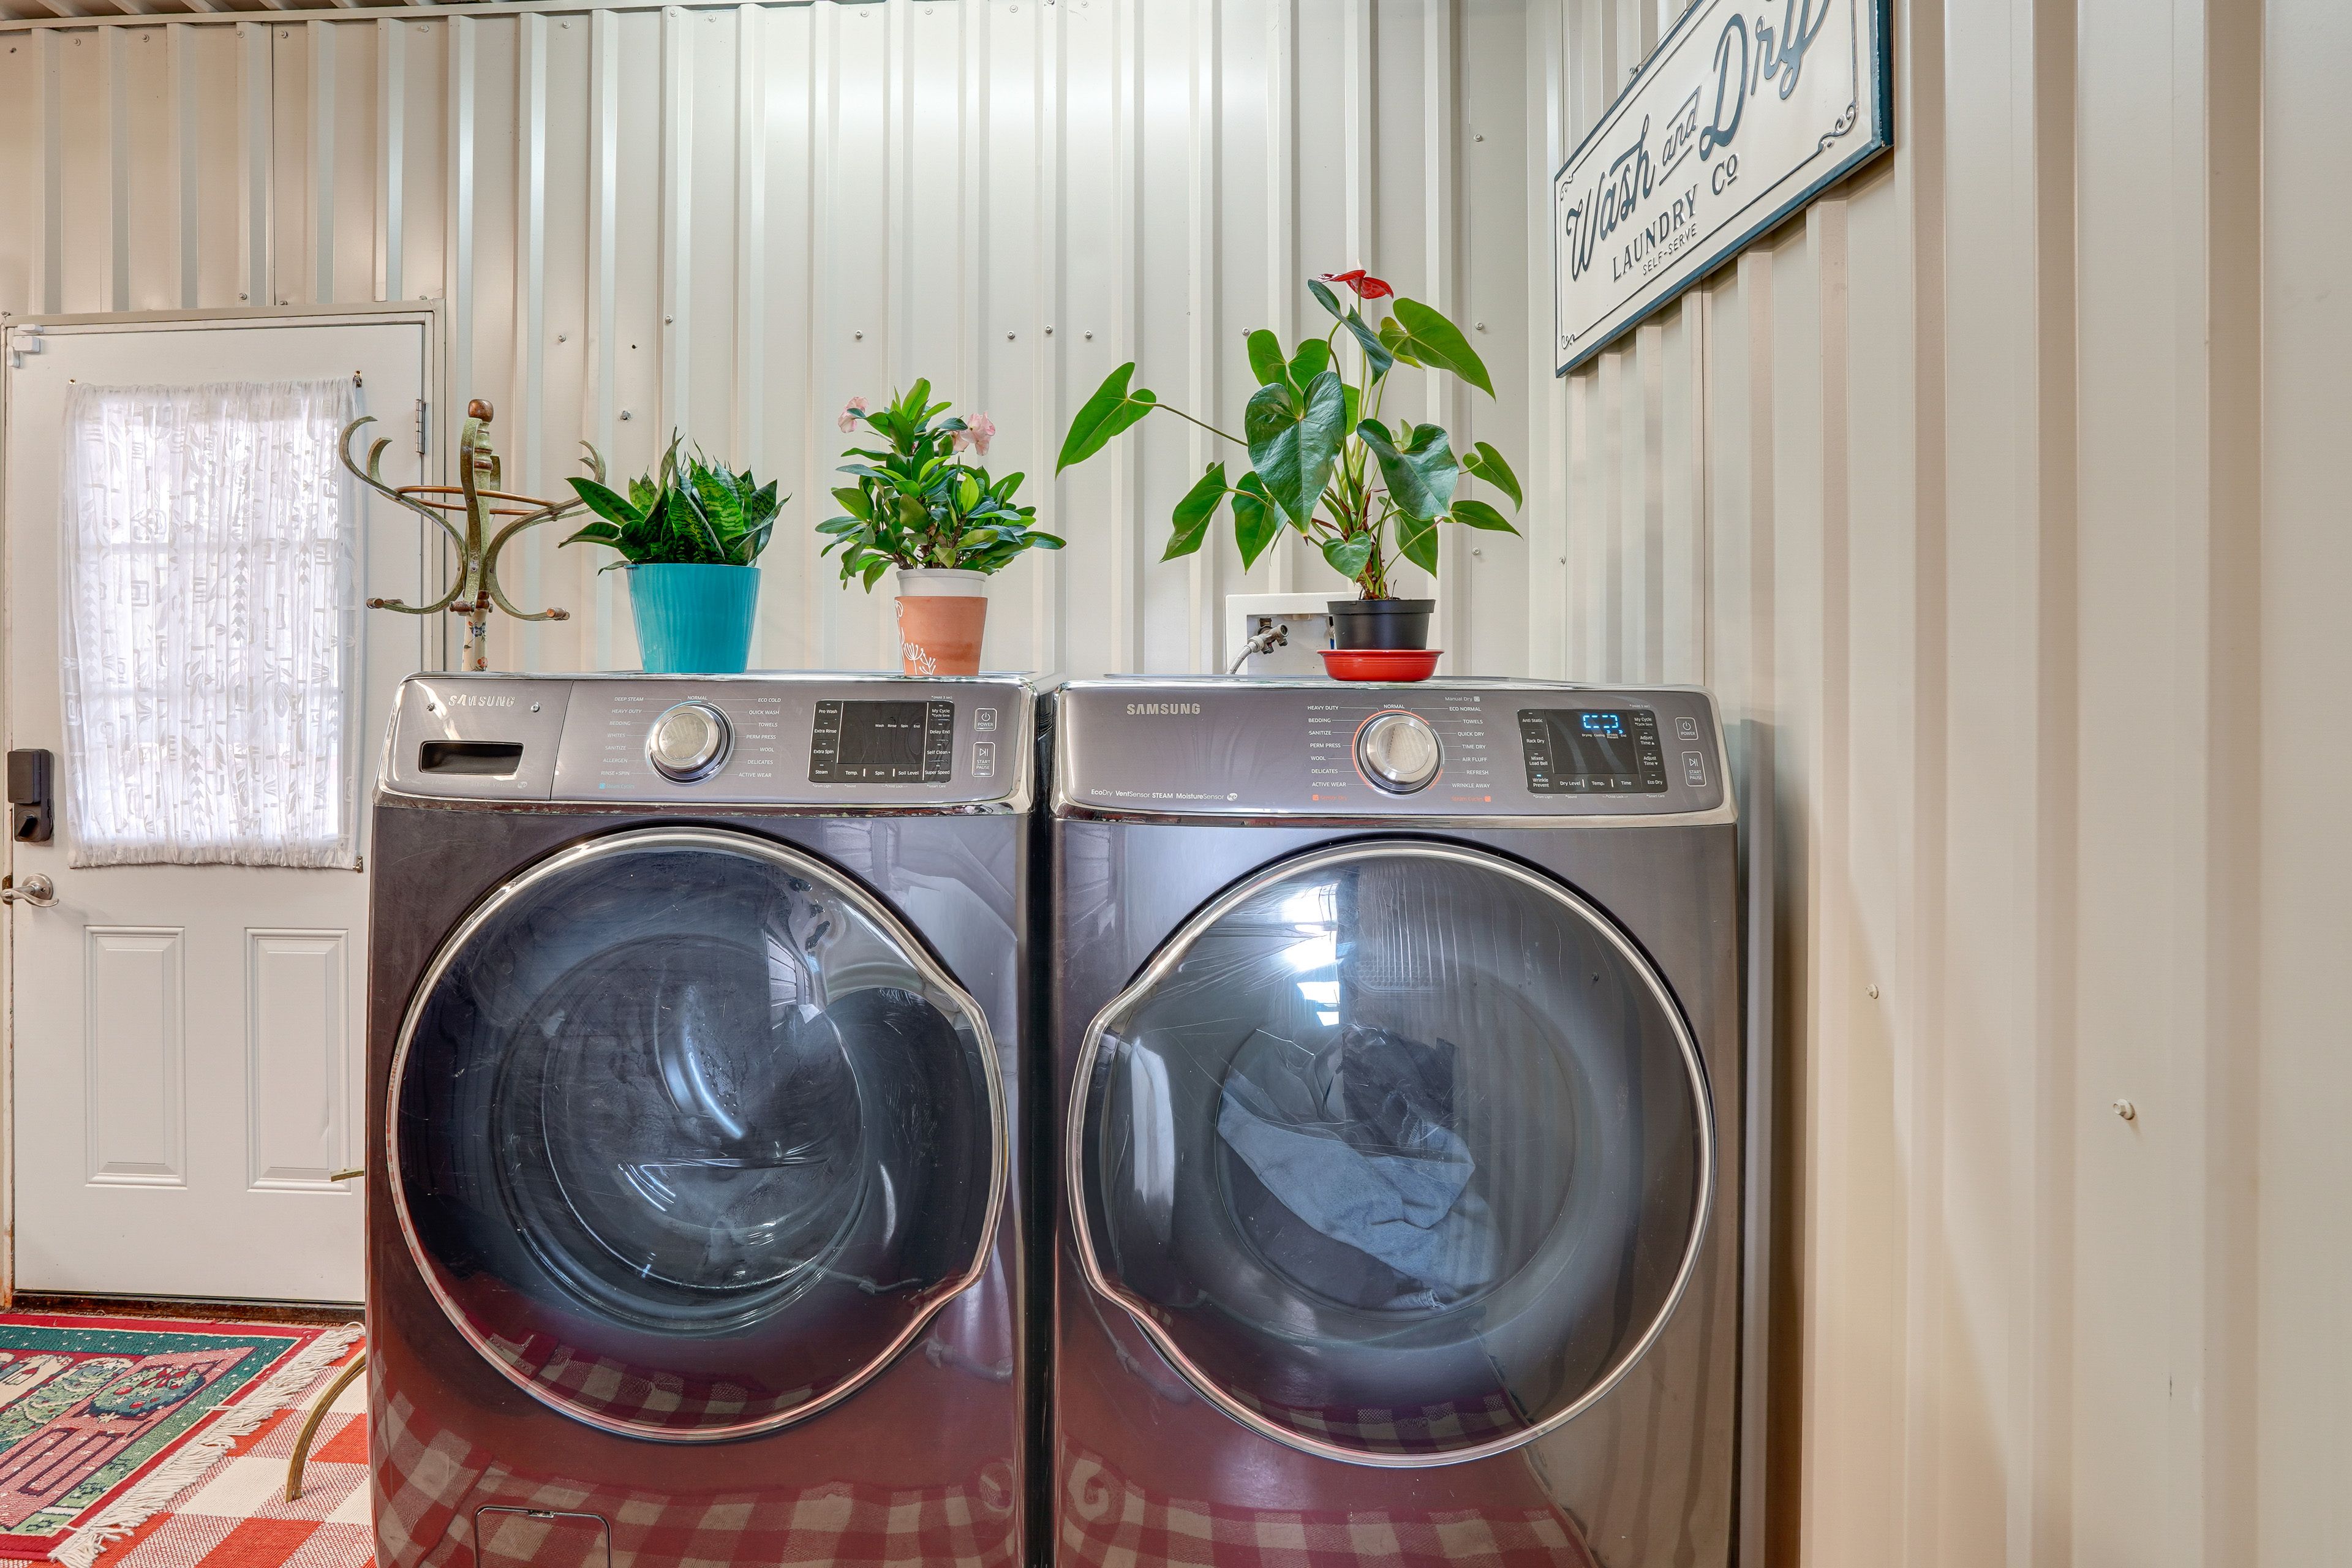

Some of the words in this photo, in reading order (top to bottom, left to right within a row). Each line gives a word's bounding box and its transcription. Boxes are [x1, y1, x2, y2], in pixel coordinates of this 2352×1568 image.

[1566, 113, 1657, 282] Wash
[1661, 85, 1702, 167] and
[1698, 0, 1830, 161] Dry
[1612, 182, 1699, 283] LAUNDRY
[1642, 222, 1698, 276] SELF-SERVE
[448, 694, 515, 707] SAMSUNG
[1126, 703, 1200, 715] SAMSUNG
